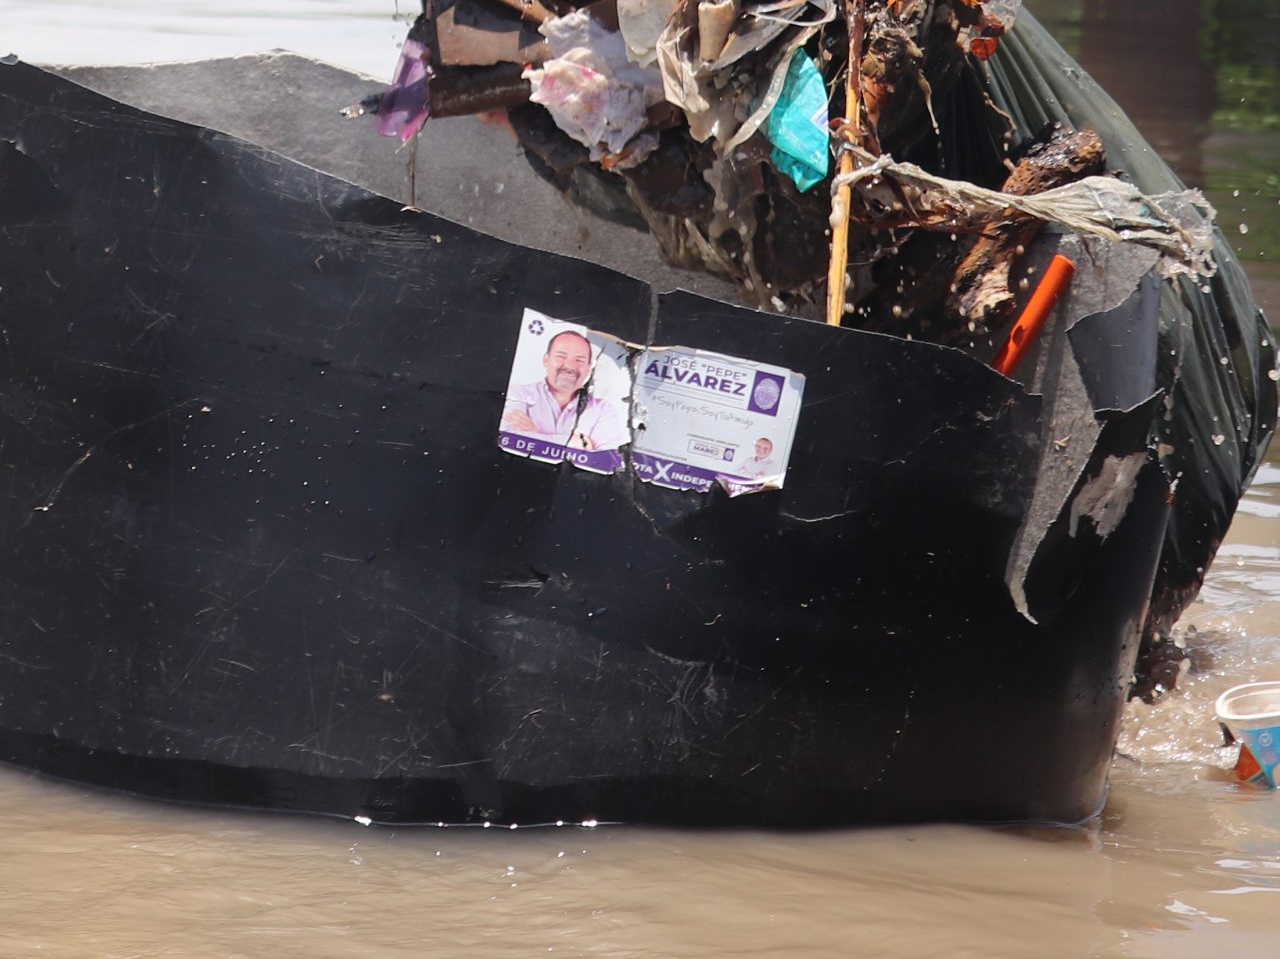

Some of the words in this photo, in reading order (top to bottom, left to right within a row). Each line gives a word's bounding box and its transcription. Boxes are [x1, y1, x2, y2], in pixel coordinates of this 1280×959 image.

[644, 359, 747, 396] ÁLVAREZ
[663, 355, 697, 371] JOSÉ
[701, 363, 747, 381] "PEPE"
[501, 436, 509, 446] 6
[516, 439, 536, 452] DE
[629, 461, 654, 475] OTA
[653, 460, 675, 482] X
